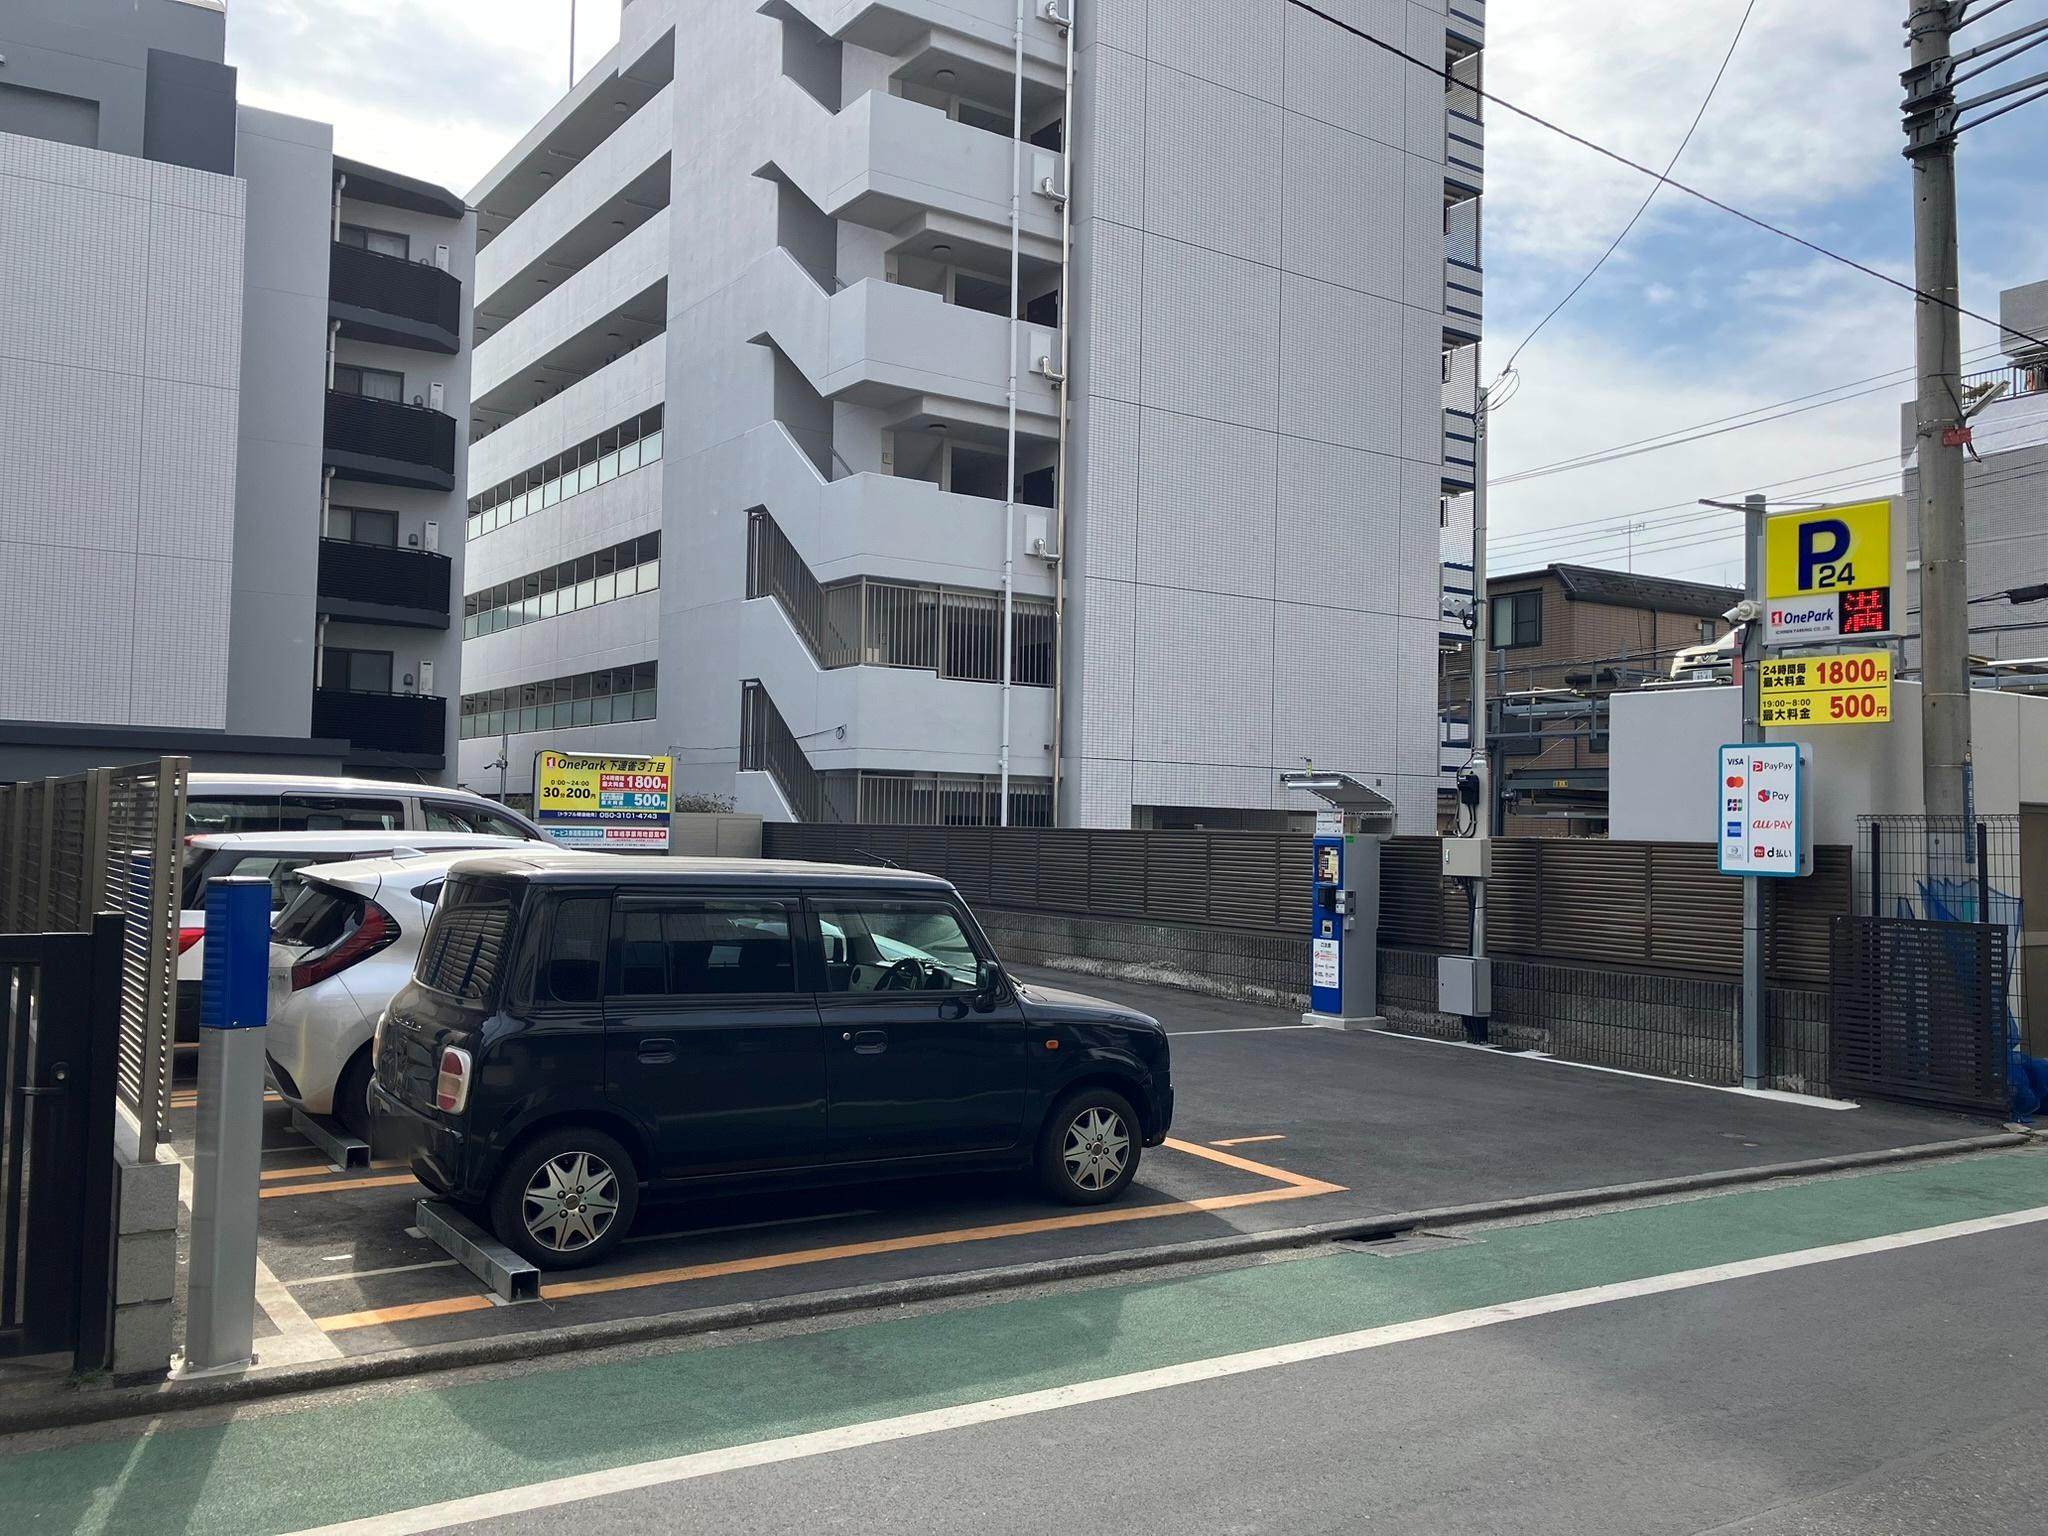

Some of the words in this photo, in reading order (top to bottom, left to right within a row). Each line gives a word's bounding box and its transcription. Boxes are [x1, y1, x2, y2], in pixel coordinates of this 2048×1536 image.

[1798, 519, 1850, 590] P
[1819, 562, 1855, 588] 24
[1784, 608, 1834, 624] OnePark
[1844, 591, 1882, 632] 満
[1763, 664, 1806, 675] 24時間毎
[1816, 659, 1887, 684] 1800円
[1763, 675, 1805, 687] 最大料金
[1830, 694, 1887, 719] 500円
[1763, 708, 1811, 721] 最大料金
[558, 759, 606, 770] OnePark
[1764, 762, 1793, 771] PayPay
[626, 775, 667, 790] 1800円
[634, 793, 666, 807] 500円
[1772, 791, 1789, 801] Pay
[1752, 820, 1773, 829] au
[1774, 820, 1792, 829] PAY
[1767, 847, 1792, 857] d払い
